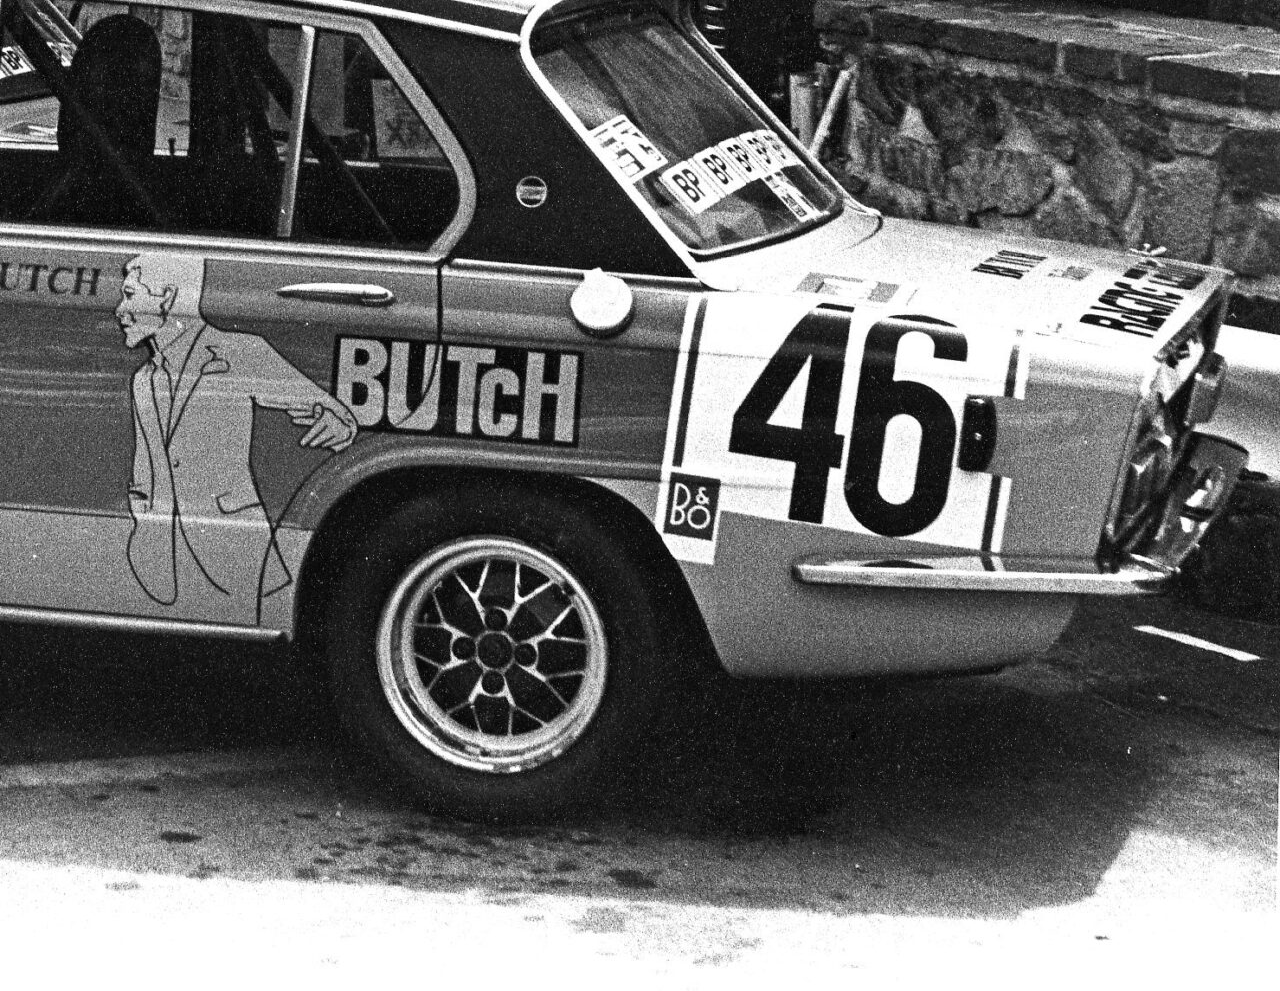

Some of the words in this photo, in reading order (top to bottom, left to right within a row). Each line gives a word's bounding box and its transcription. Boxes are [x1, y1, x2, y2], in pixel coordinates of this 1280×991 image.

[672, 169, 706, 203] BP
[702, 154, 733, 185] BP
[336, 337, 579, 445] BUTCH
[729, 301, 969, 537] 46
